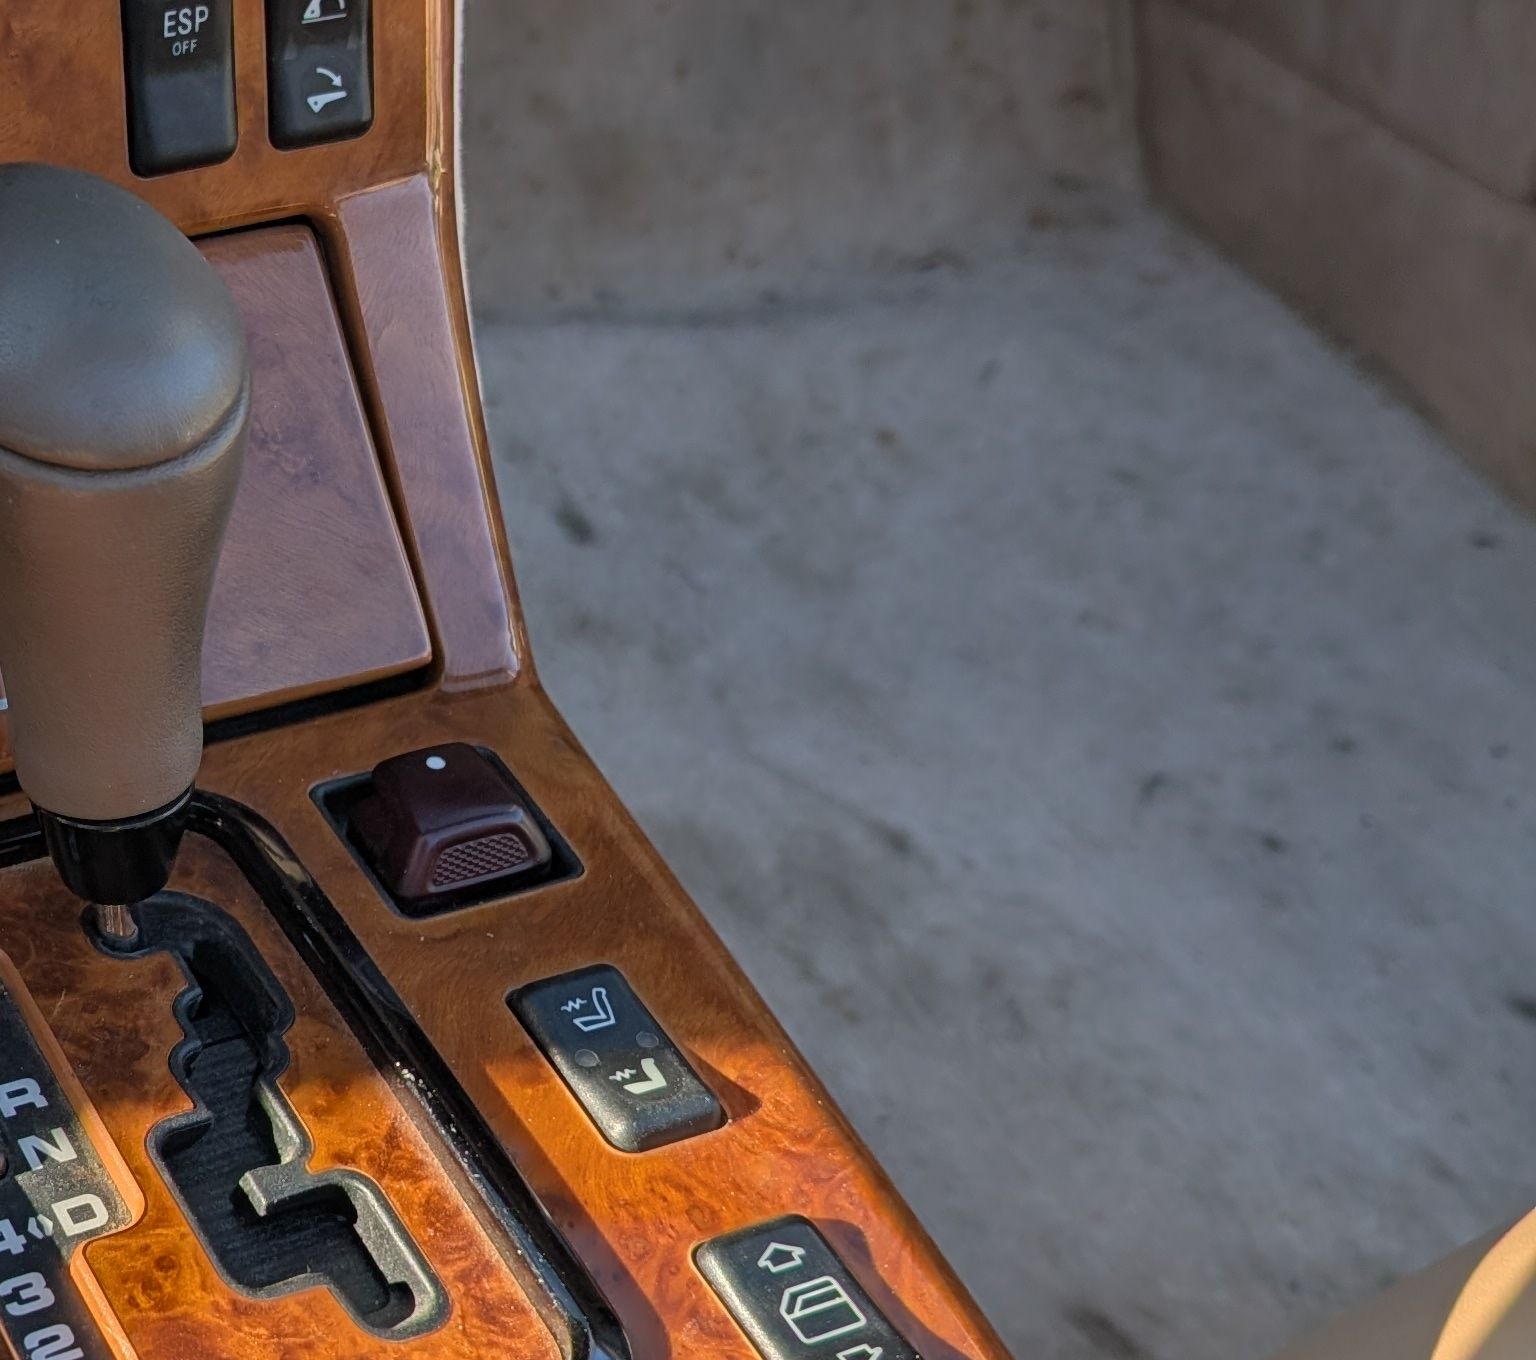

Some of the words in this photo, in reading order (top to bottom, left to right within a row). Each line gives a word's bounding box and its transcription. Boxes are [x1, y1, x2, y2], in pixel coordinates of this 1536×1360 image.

[164, 5, 209, 38] ESP
[172, 40, 198, 56] OFF
[17, 1127, 77, 1171] N
[51, 1193, 109, 1237] D
